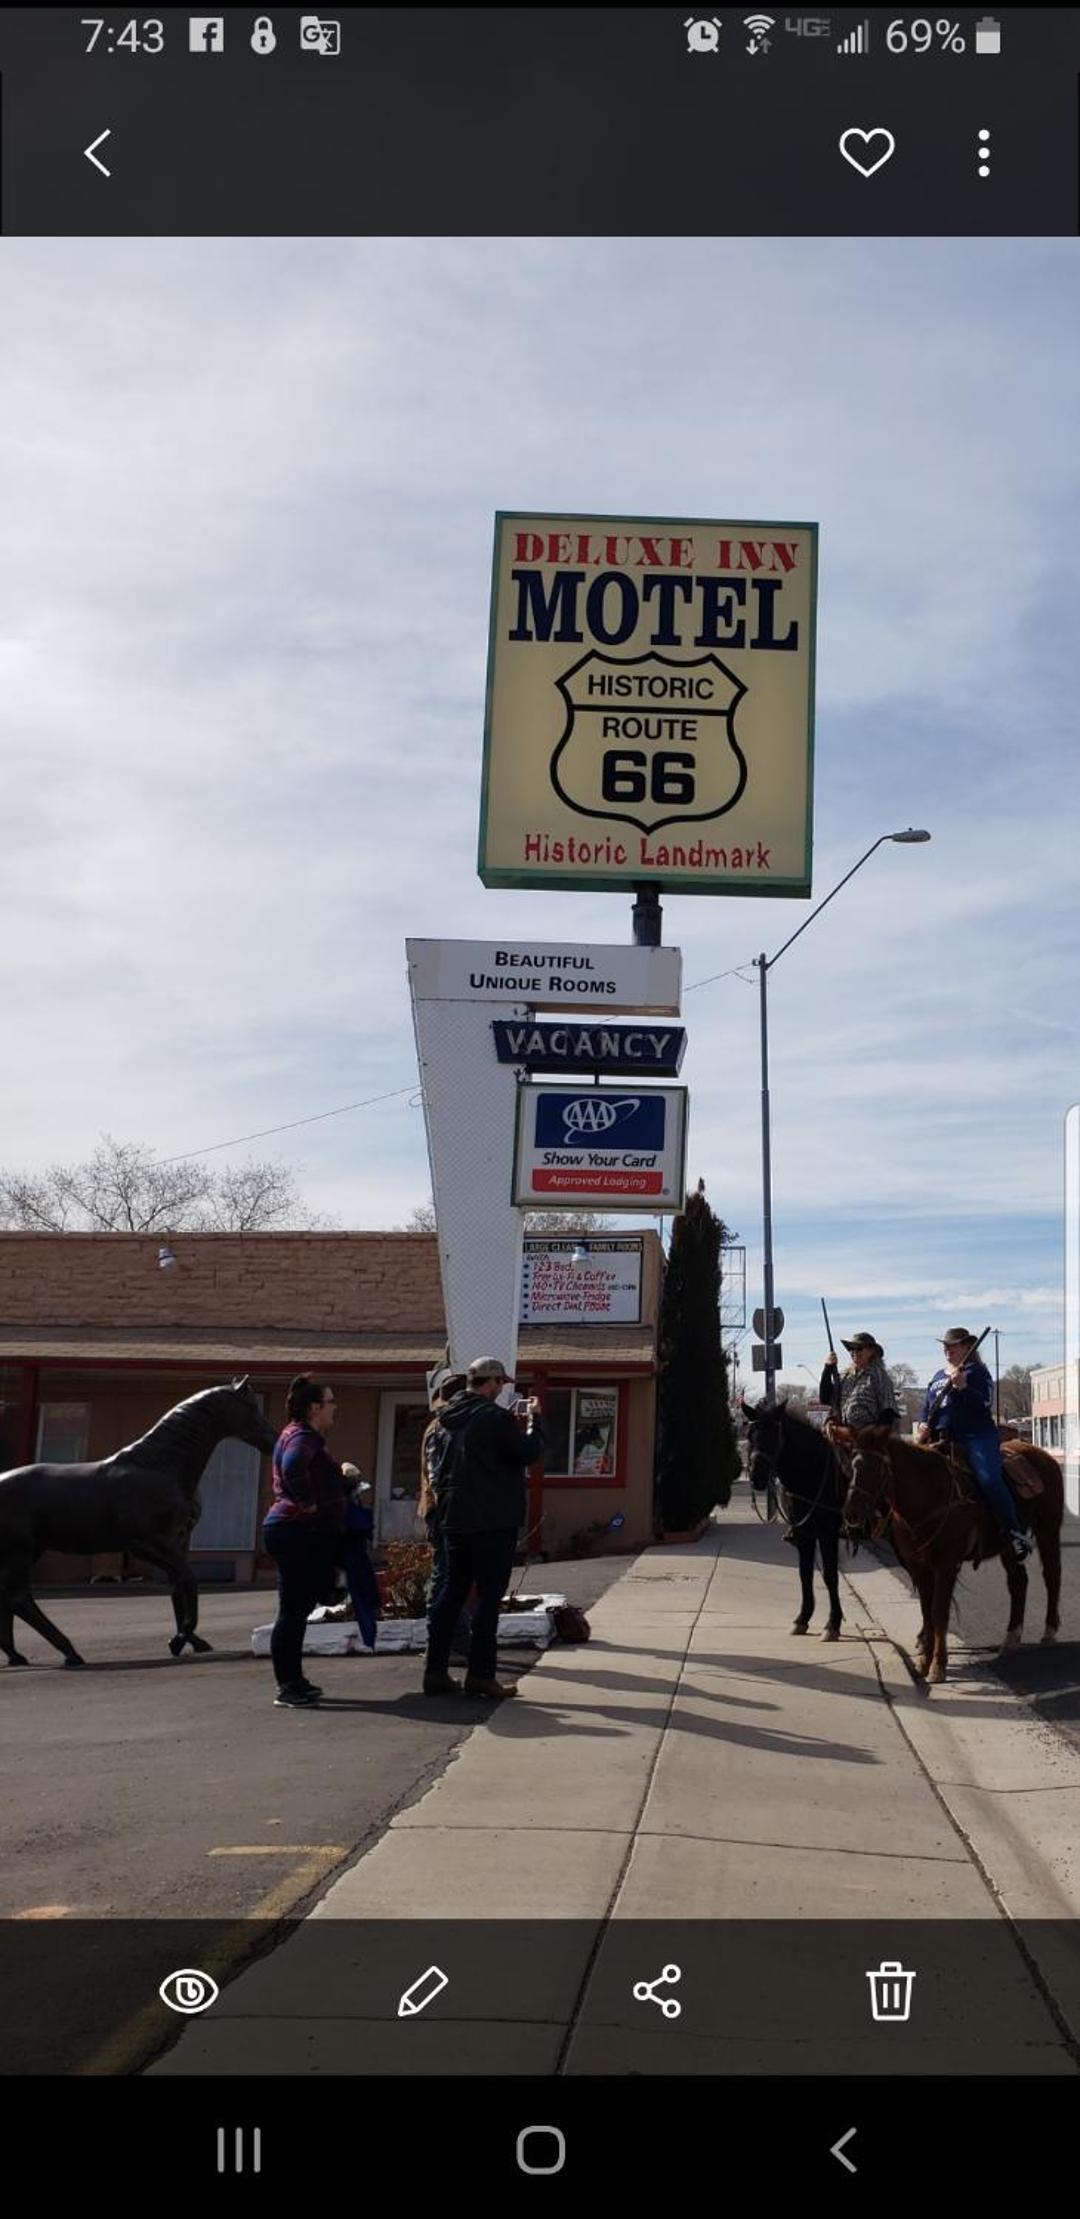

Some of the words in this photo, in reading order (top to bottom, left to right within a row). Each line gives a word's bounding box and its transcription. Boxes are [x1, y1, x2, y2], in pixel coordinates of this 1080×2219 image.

[513, 532, 695, 568] DELUXE
[717, 540, 800, 573] INN
[508, 569, 799, 652] MOTEL
[587, 674, 715, 700] HISTORIC
[602, 716, 698, 741] ROUTE
[601, 749, 696, 805] 66
[524, 833, 628, 866] Historic
[640, 837, 771, 869] Landmark
[494, 950, 595, 970] BEAUTIFUL
[469, 973, 542, 991] UNIQUE
[548, 976, 617, 994] ROOMS
[505, 1028, 671, 1059] VACANCY
[566, 1100, 609, 1132] AAA
[541, 1151, 583, 1166] Show
[587, 1153, 620, 1167] Your
[622, 1154, 657, 1168] Card
[548, 1174, 601, 1187] Approved
[603, 1176, 647, 1189] Lodging
